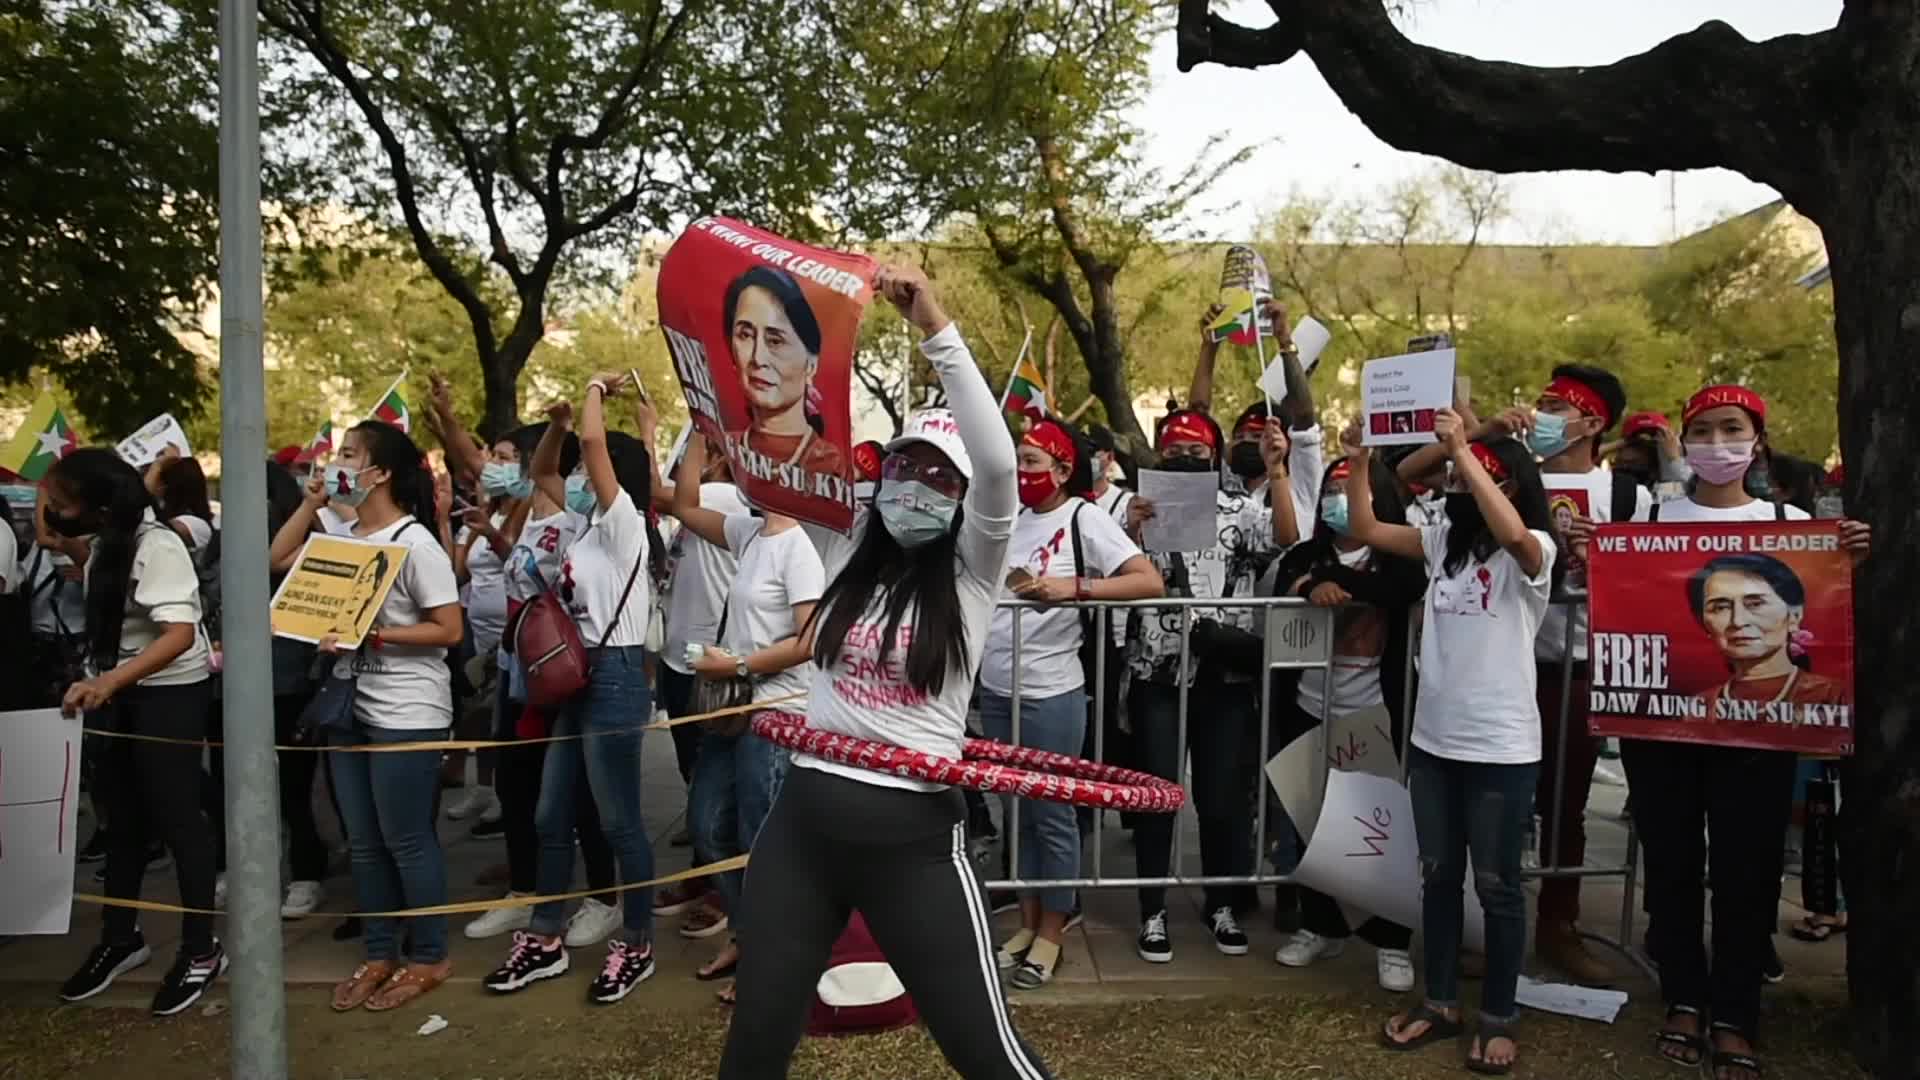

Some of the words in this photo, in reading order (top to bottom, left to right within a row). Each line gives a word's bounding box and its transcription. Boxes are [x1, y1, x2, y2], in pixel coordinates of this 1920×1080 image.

[709, 224, 760, 249] WANT
[751, 243, 793, 266] OUR
[786, 256, 864, 298] LEADER
[1597, 535, 1626, 552] WE
[1632, 535, 1690, 551] WANT
[1696, 535, 1742, 550] OUR
[1749, 534, 1839, 551] LEADER
[1593, 633, 1668, 689] FREE
[1590, 691, 1639, 713] DAW
[1647, 695, 1707, 718] AUNG
[1803, 703, 1849, 727] KYI
[1344, 807, 1392, 857] We
